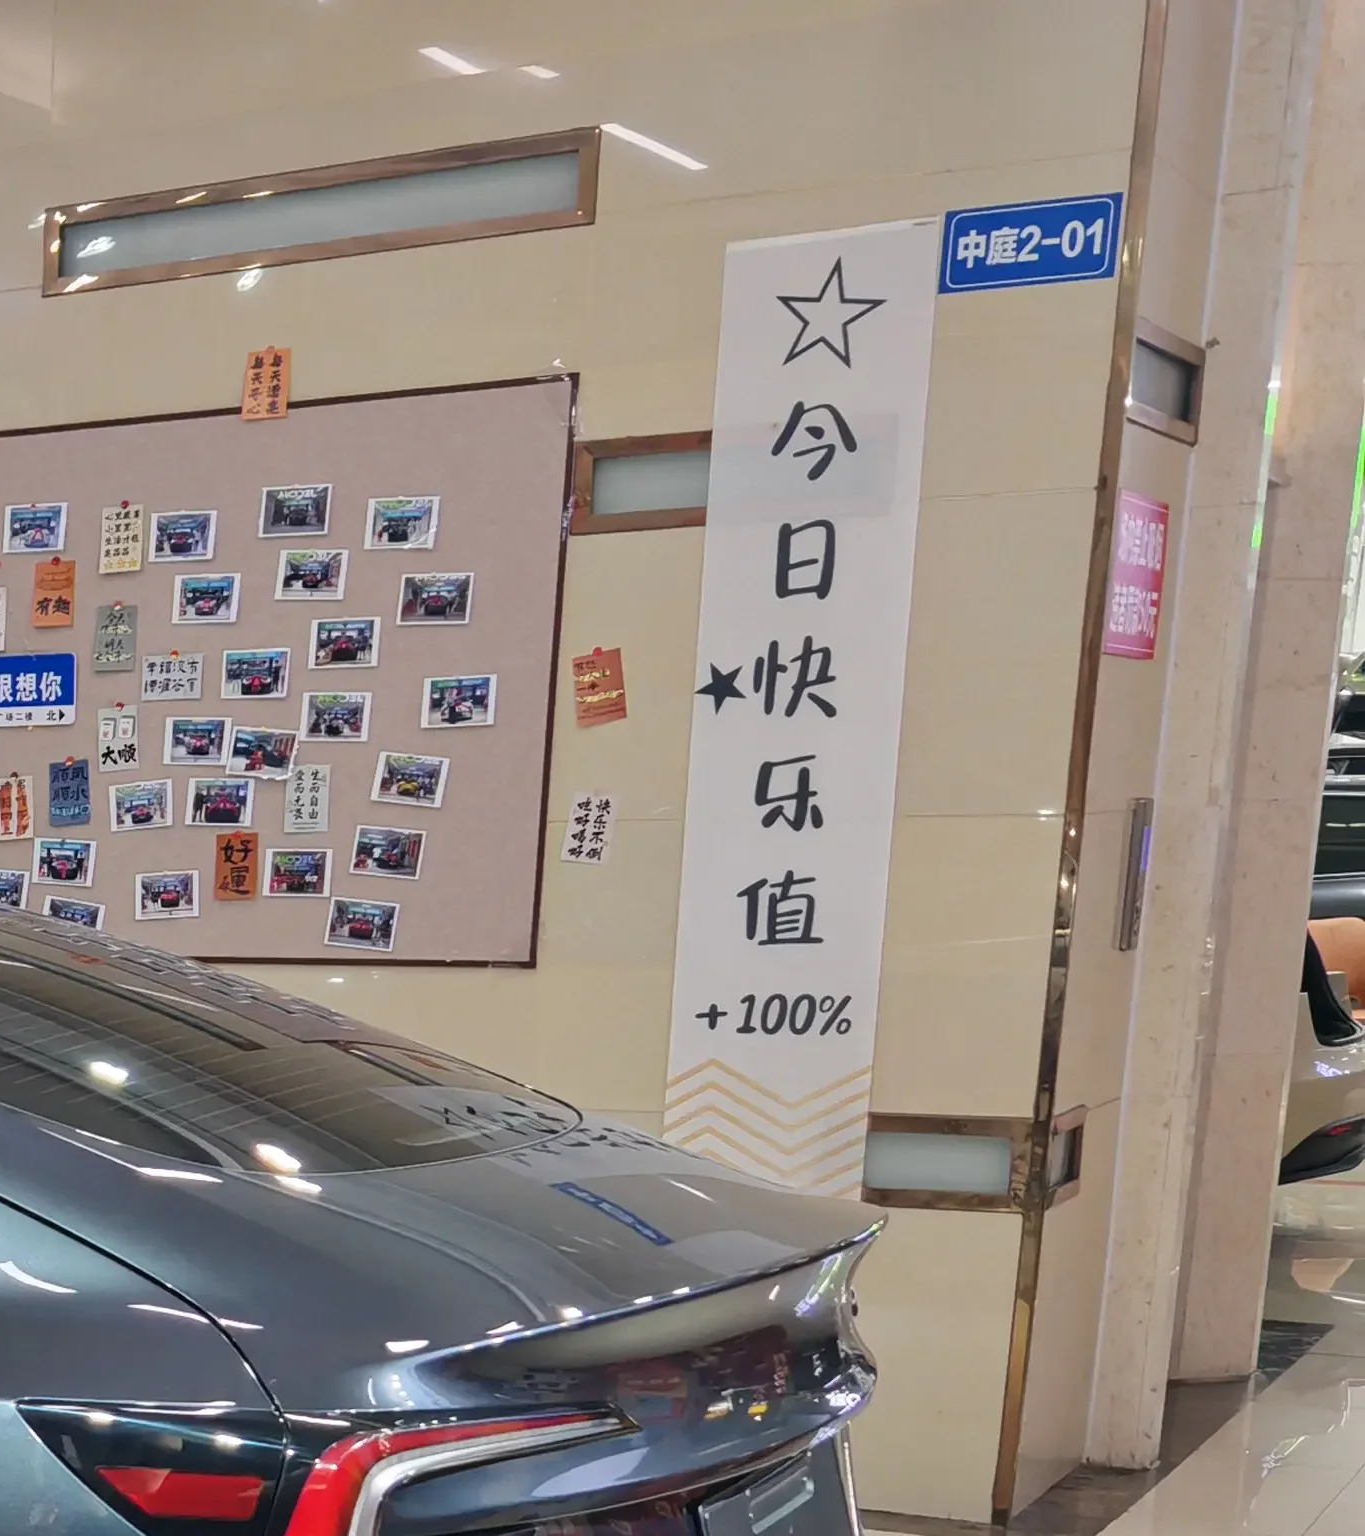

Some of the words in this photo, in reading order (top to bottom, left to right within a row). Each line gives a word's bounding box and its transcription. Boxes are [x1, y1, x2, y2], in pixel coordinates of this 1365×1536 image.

[956, 216, 1106, 270] 中庭2-01
[736, 400, 858, 948] 今日快乐值
[696, 993, 853, 1039] +100%
